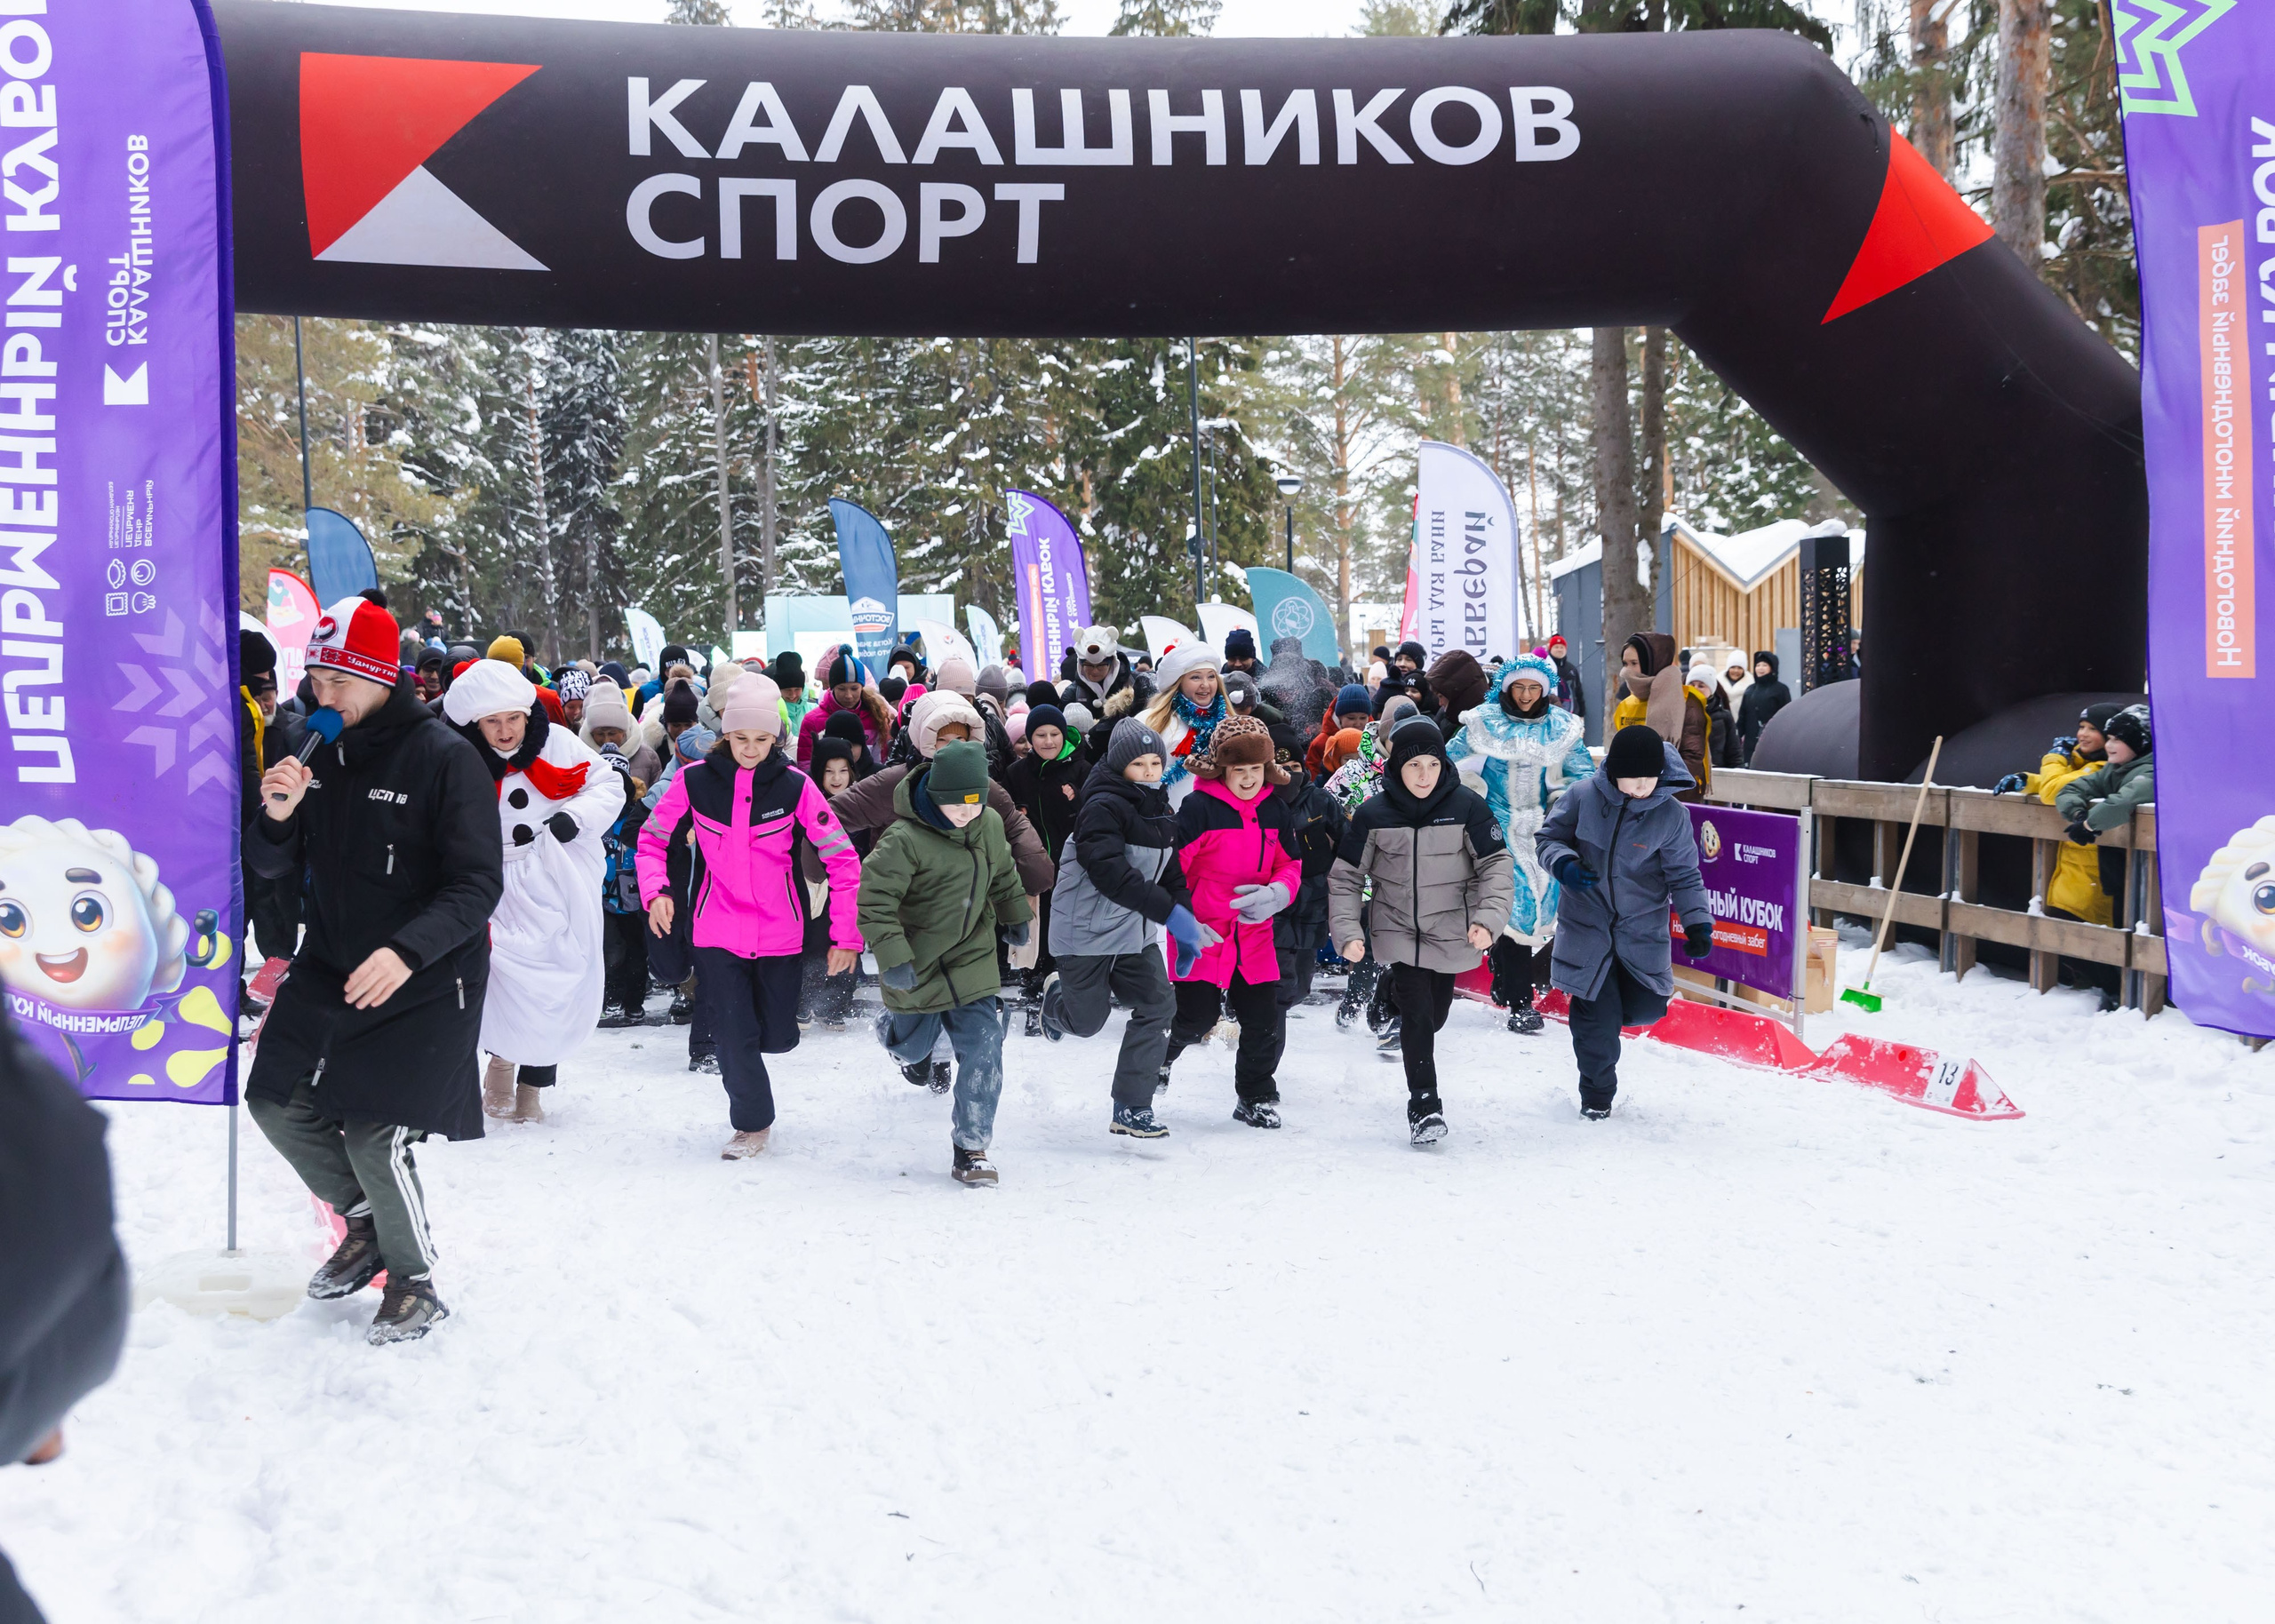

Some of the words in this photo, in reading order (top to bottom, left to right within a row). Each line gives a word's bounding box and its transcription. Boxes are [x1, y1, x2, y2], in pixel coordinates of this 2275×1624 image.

[626, 76, 1581, 166] КАЛАШНИКОВ
[626, 173, 1065, 264] СПОРТ
[1398, 744, 1441, 766] FILA
[368, 788, 395, 801] ЦСП
[395, 793, 408, 804] 18
[1743, 845, 1776, 858] КАЛАШНИКОВ
[1743, 853, 1758, 864] СПОРТ
[1707, 887, 1739, 920] НЫЙ
[1740, 896, 1784, 932] КУБОК
[1747, 934, 1766, 949] забег
[1938, 1062, 1959, 1086] 13
